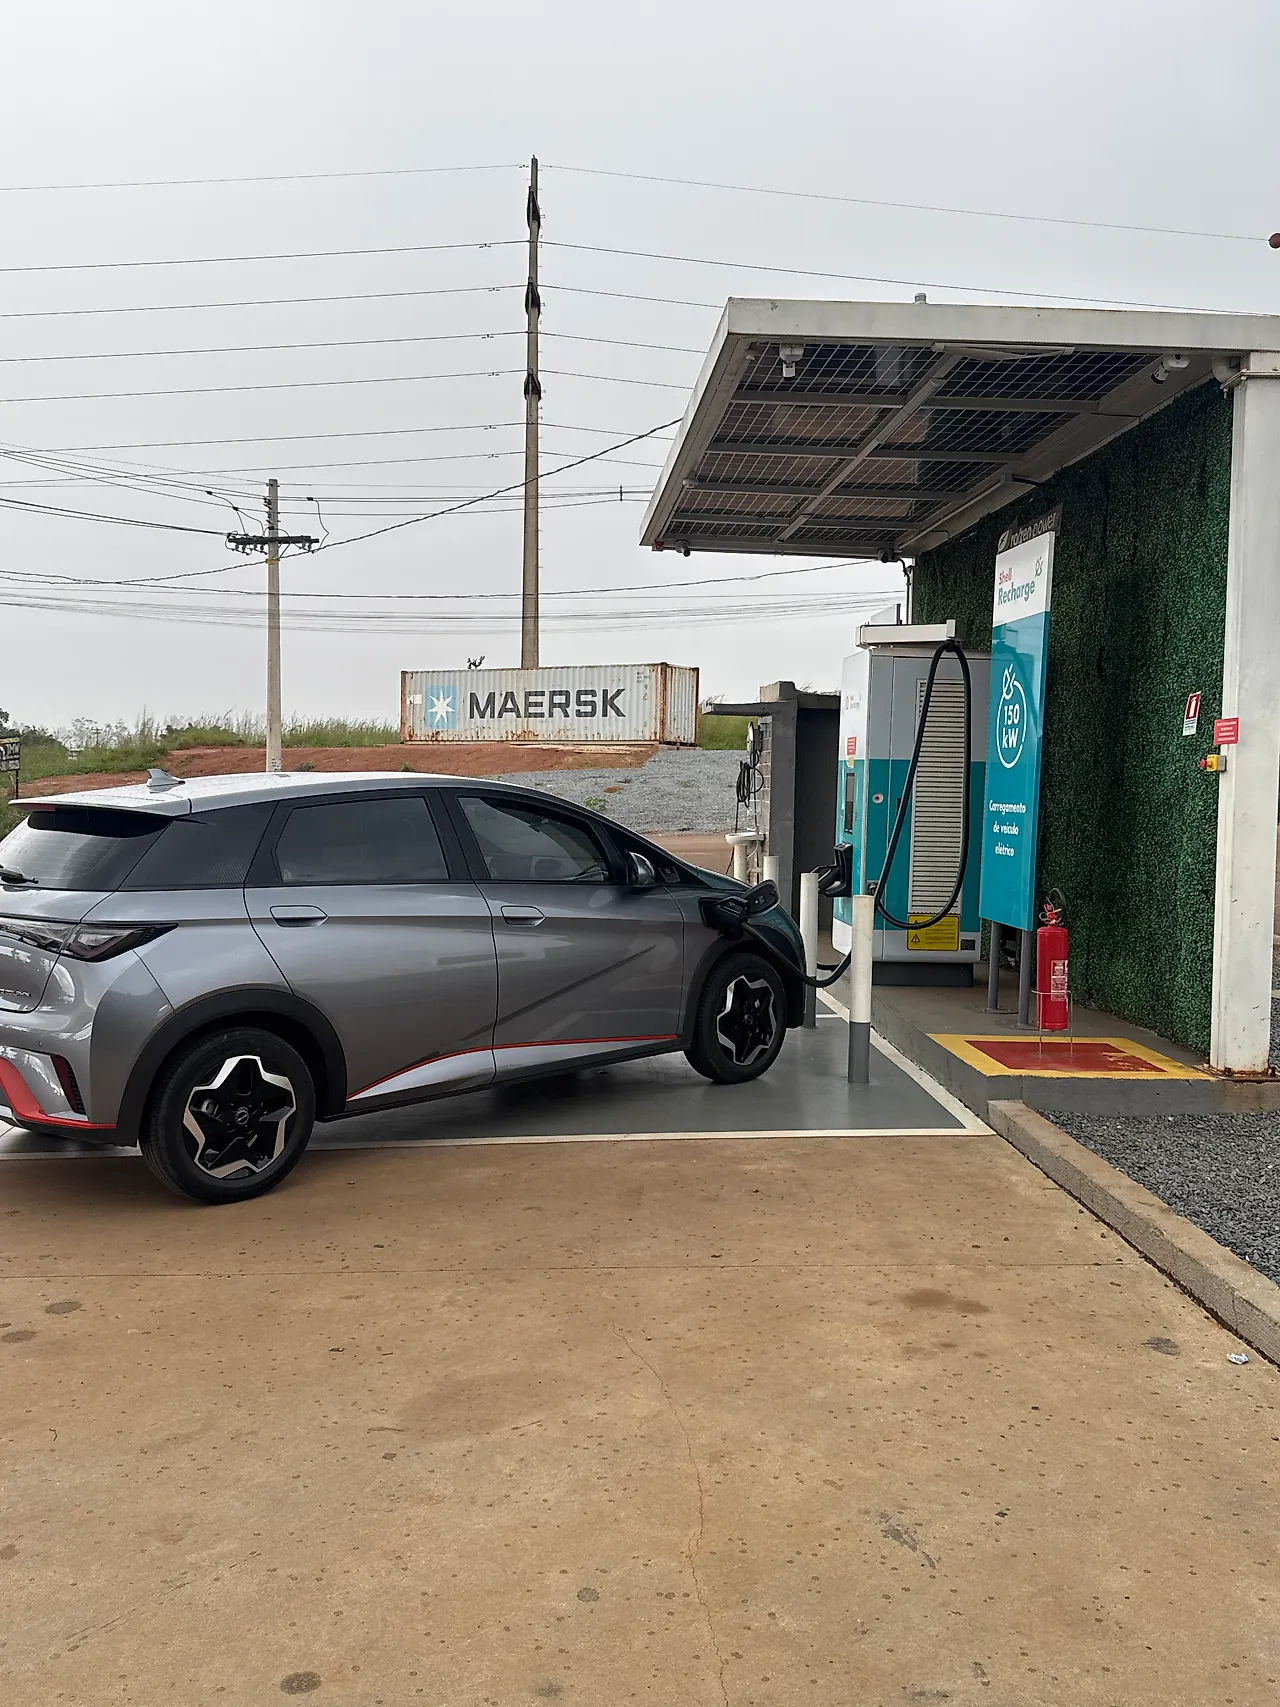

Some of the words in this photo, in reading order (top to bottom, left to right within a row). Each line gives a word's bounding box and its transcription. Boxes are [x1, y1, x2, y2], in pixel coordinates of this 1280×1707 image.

[998, 568, 1013, 585] Shell
[998, 580, 1035, 605] Recharge
[469, 689, 626, 719] MAERSK
[1004, 703, 1020, 725] 150
[1002, 727, 1019, 748] kW
[989, 800, 1026, 815] Carregamento
[993, 820, 1000, 834] de
